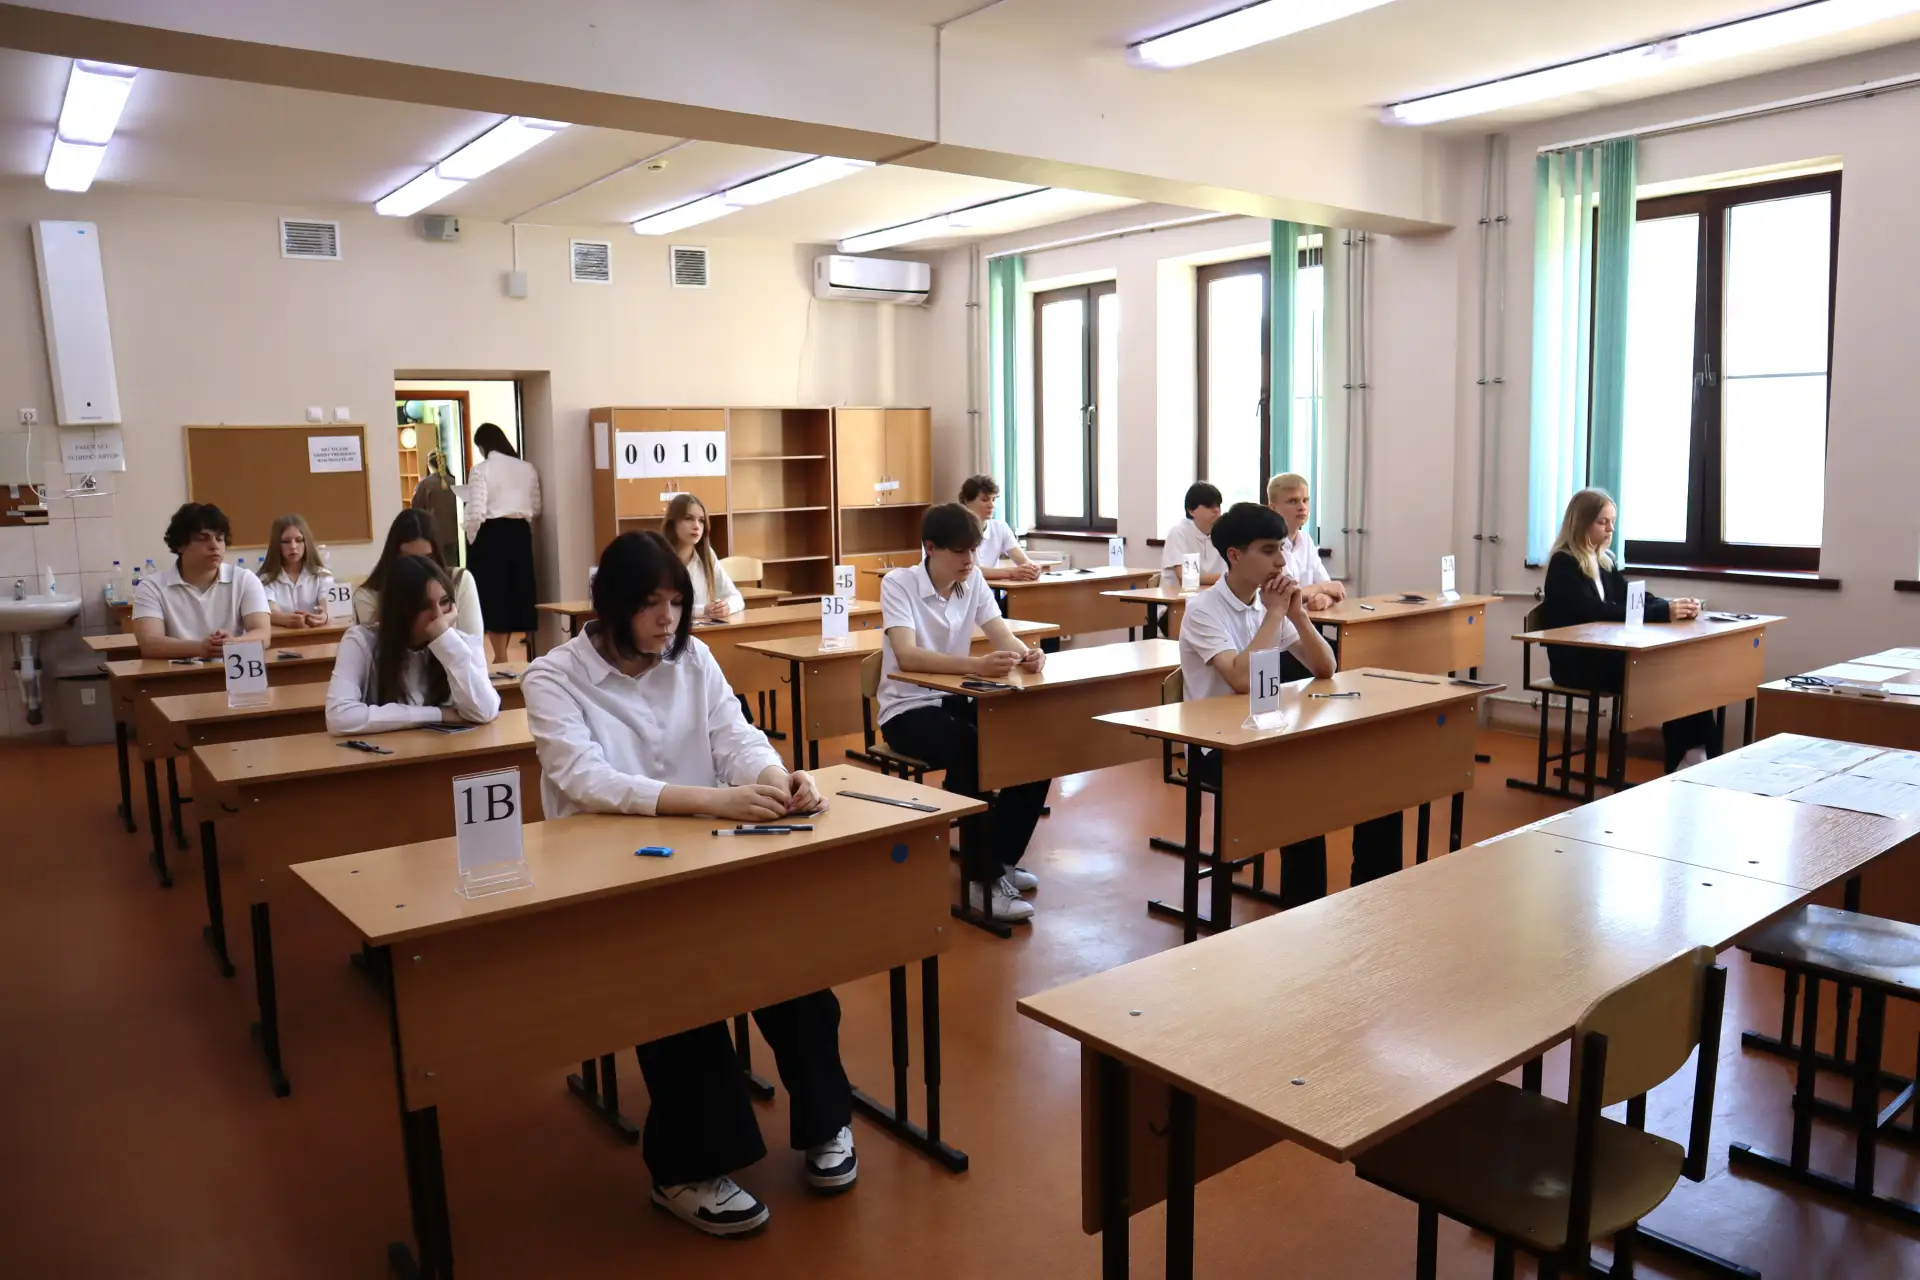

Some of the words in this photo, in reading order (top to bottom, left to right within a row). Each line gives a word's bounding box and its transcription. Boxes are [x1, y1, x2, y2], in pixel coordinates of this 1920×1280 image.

[836, 573, 853, 588] 4Б
[328, 587, 350, 602] 5В
[823, 597, 844, 615] 3Б
[228, 654, 264, 680] 3В
[1258, 669, 1279, 699] 1Б
[461, 783, 515, 825] 1В
